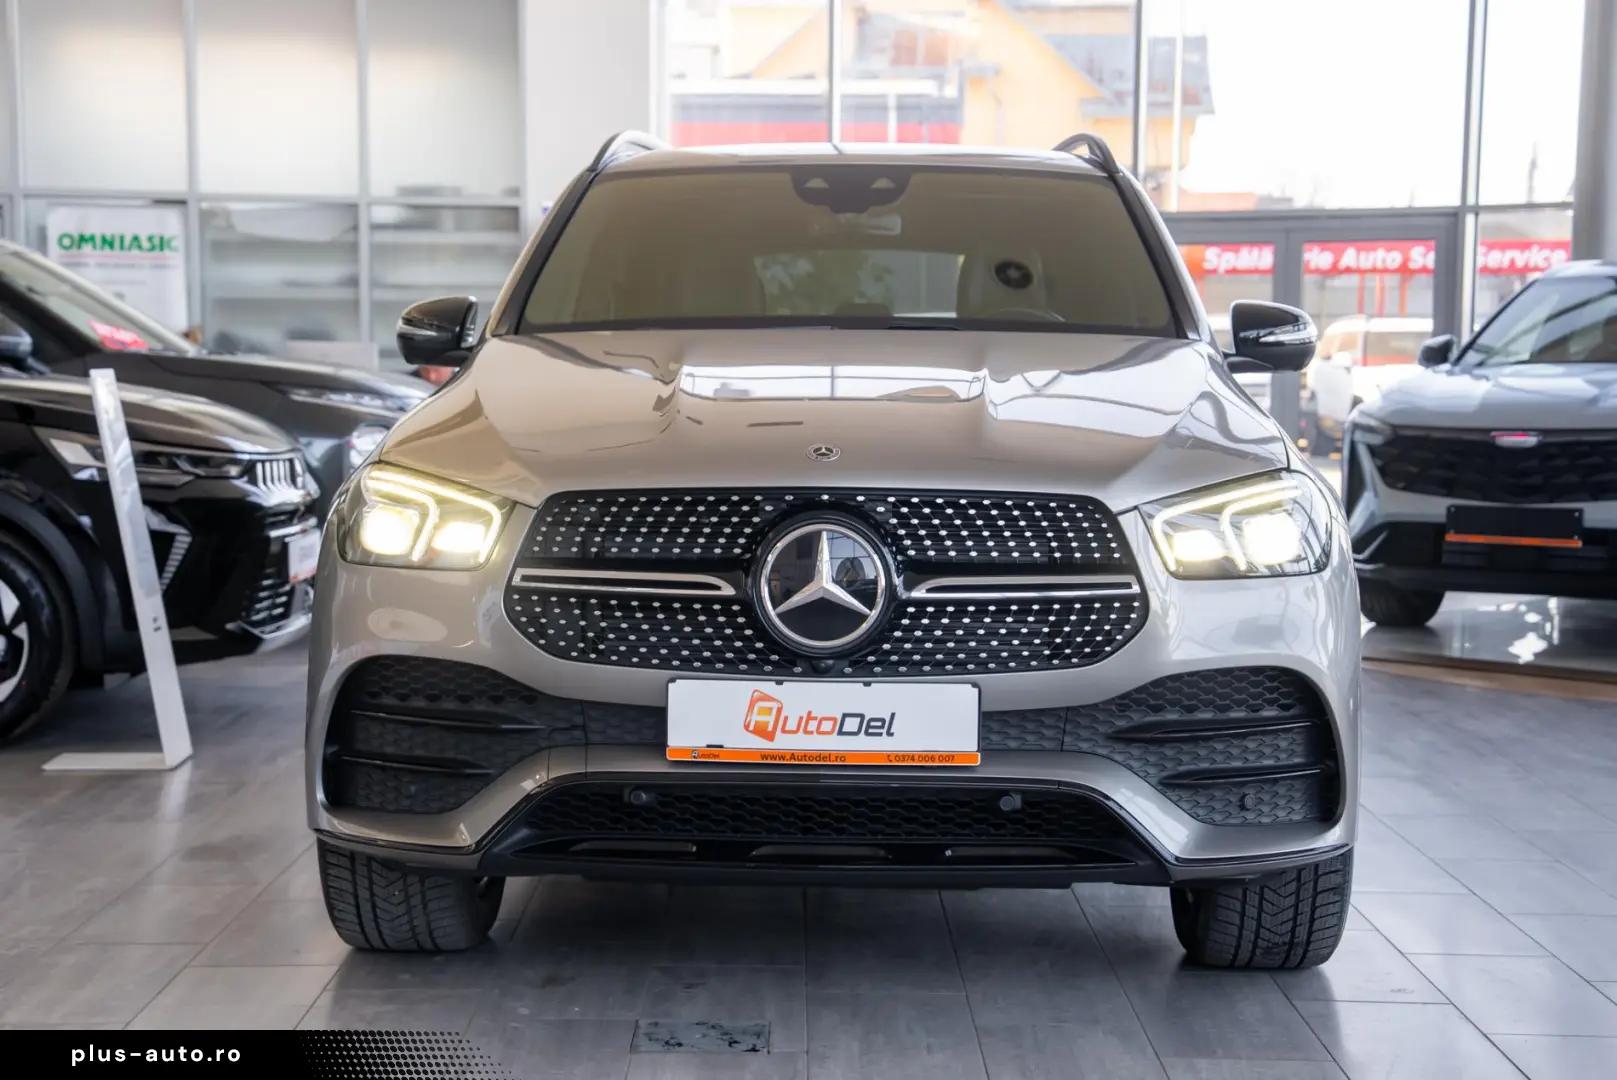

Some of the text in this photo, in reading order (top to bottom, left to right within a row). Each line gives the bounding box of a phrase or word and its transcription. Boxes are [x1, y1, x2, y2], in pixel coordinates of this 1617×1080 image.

[1337, 246, 1404, 271] Auto
[746, 697, 896, 739] AutoDel
[760, 752, 847, 764] www.Autodel.ro
[894, 754, 955, 764] 0374 006 007
